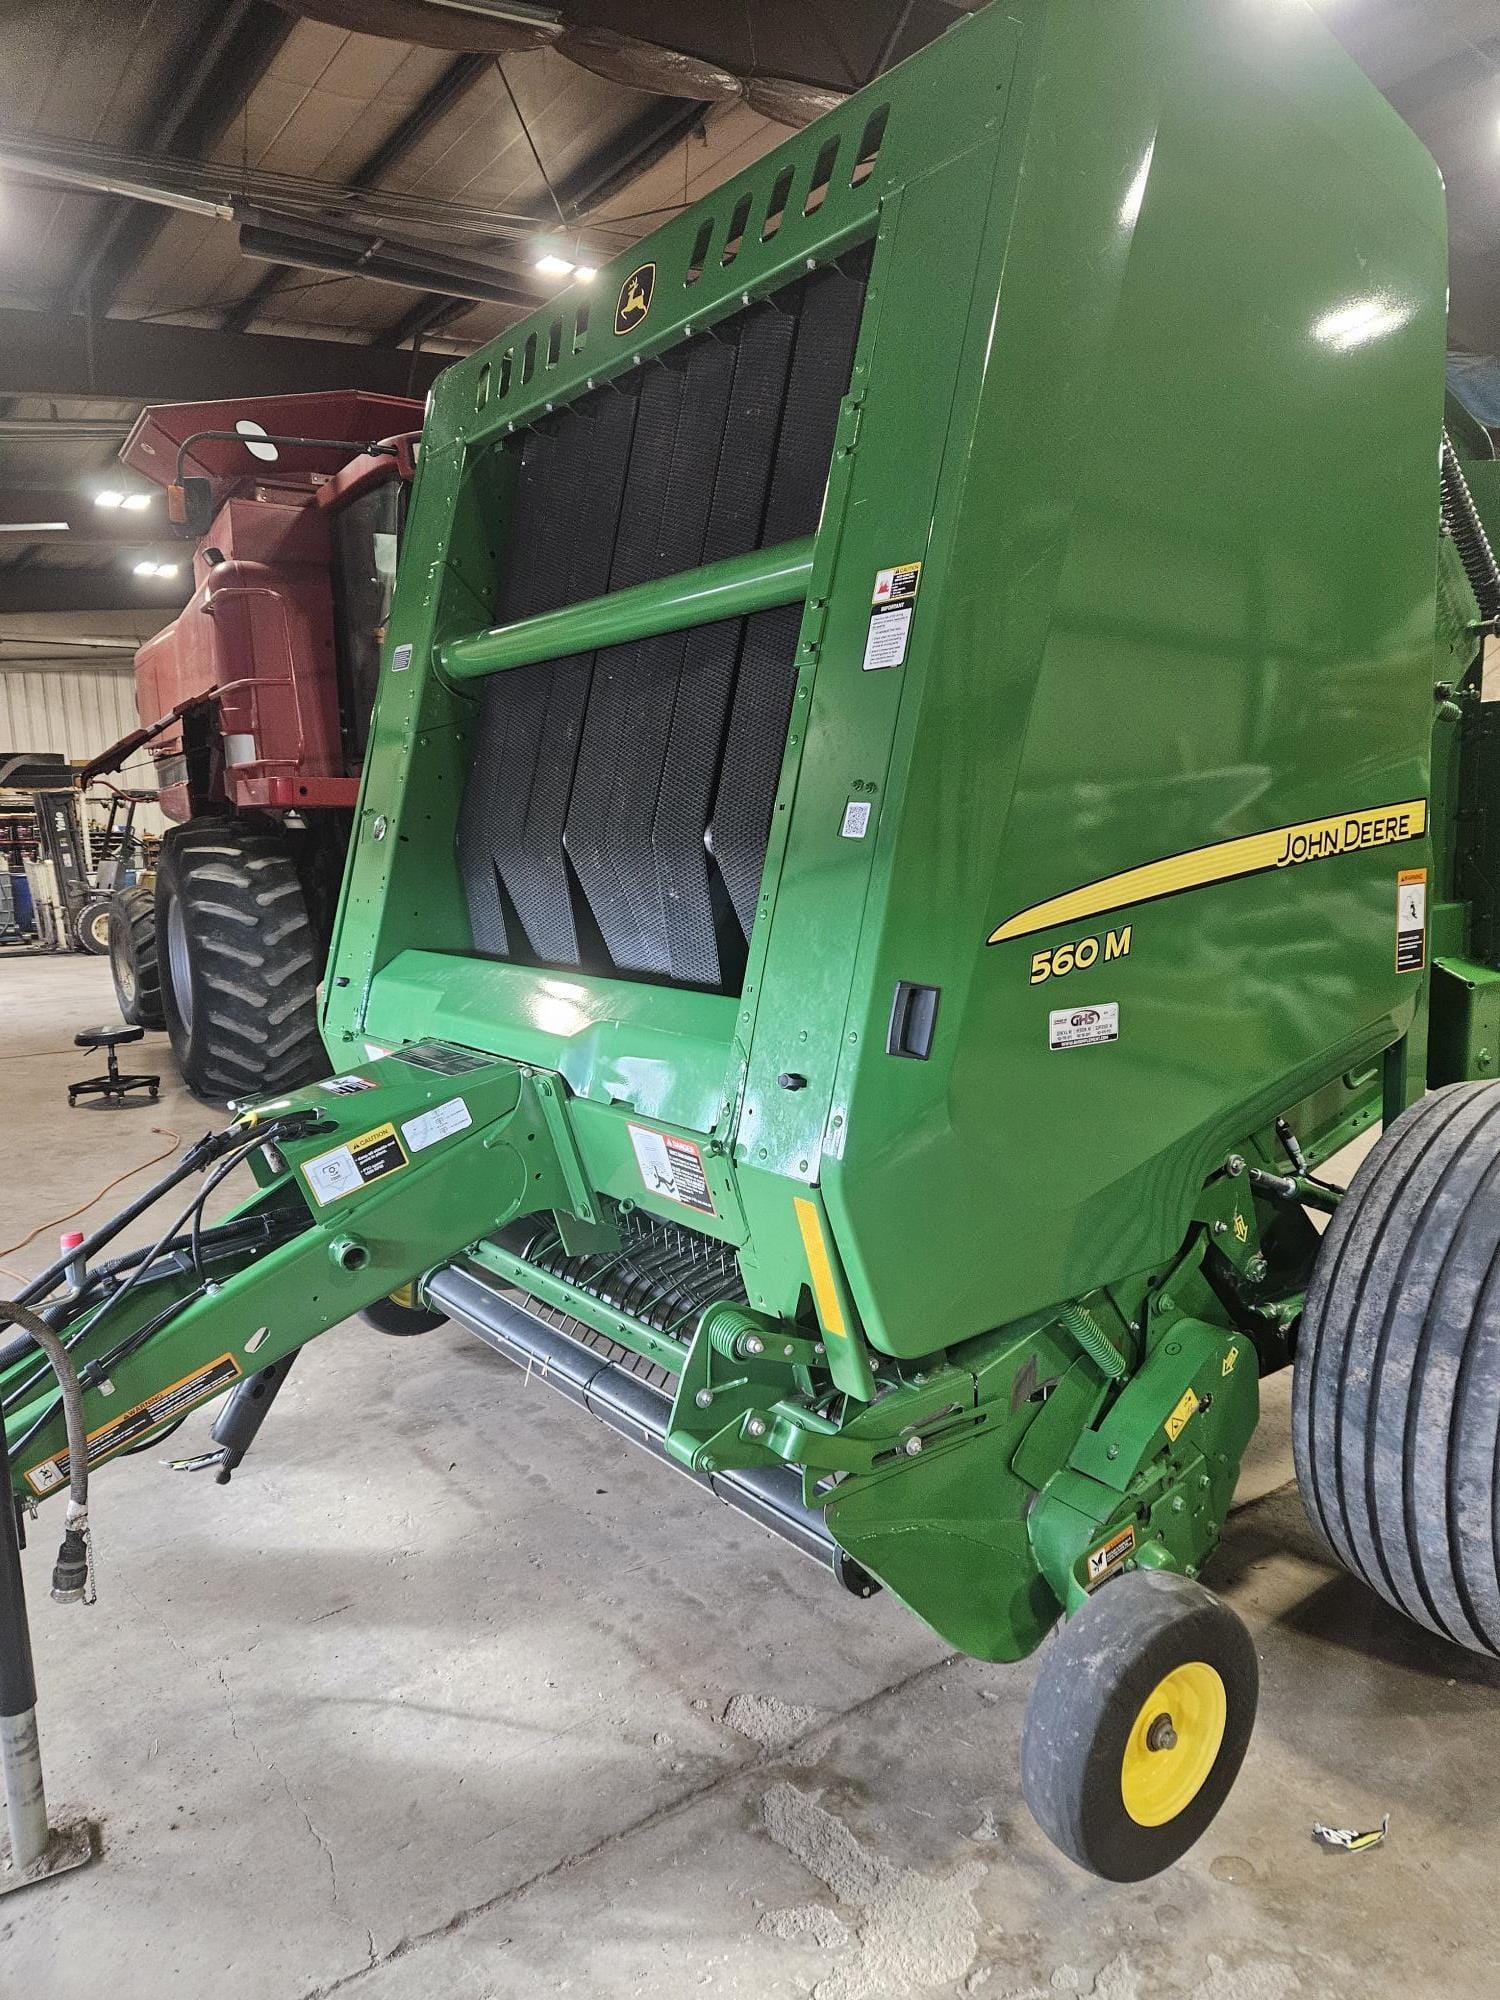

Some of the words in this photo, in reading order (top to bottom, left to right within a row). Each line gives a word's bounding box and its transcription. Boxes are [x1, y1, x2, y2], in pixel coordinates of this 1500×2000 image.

[881, 602, 905, 612] IMPORTANT
[55, 811, 66, 832] Yale
[1277, 827, 1339, 863] JOHN
[1343, 814, 1411, 848] DEERE
[1029, 935, 1100, 985] 560
[1104, 924, 1133, 963] M
[1071, 1010, 1099, 1027] GHS
[360, 1129, 389, 1146] CAUTION
[127, 1393, 163, 1417] WARNING
